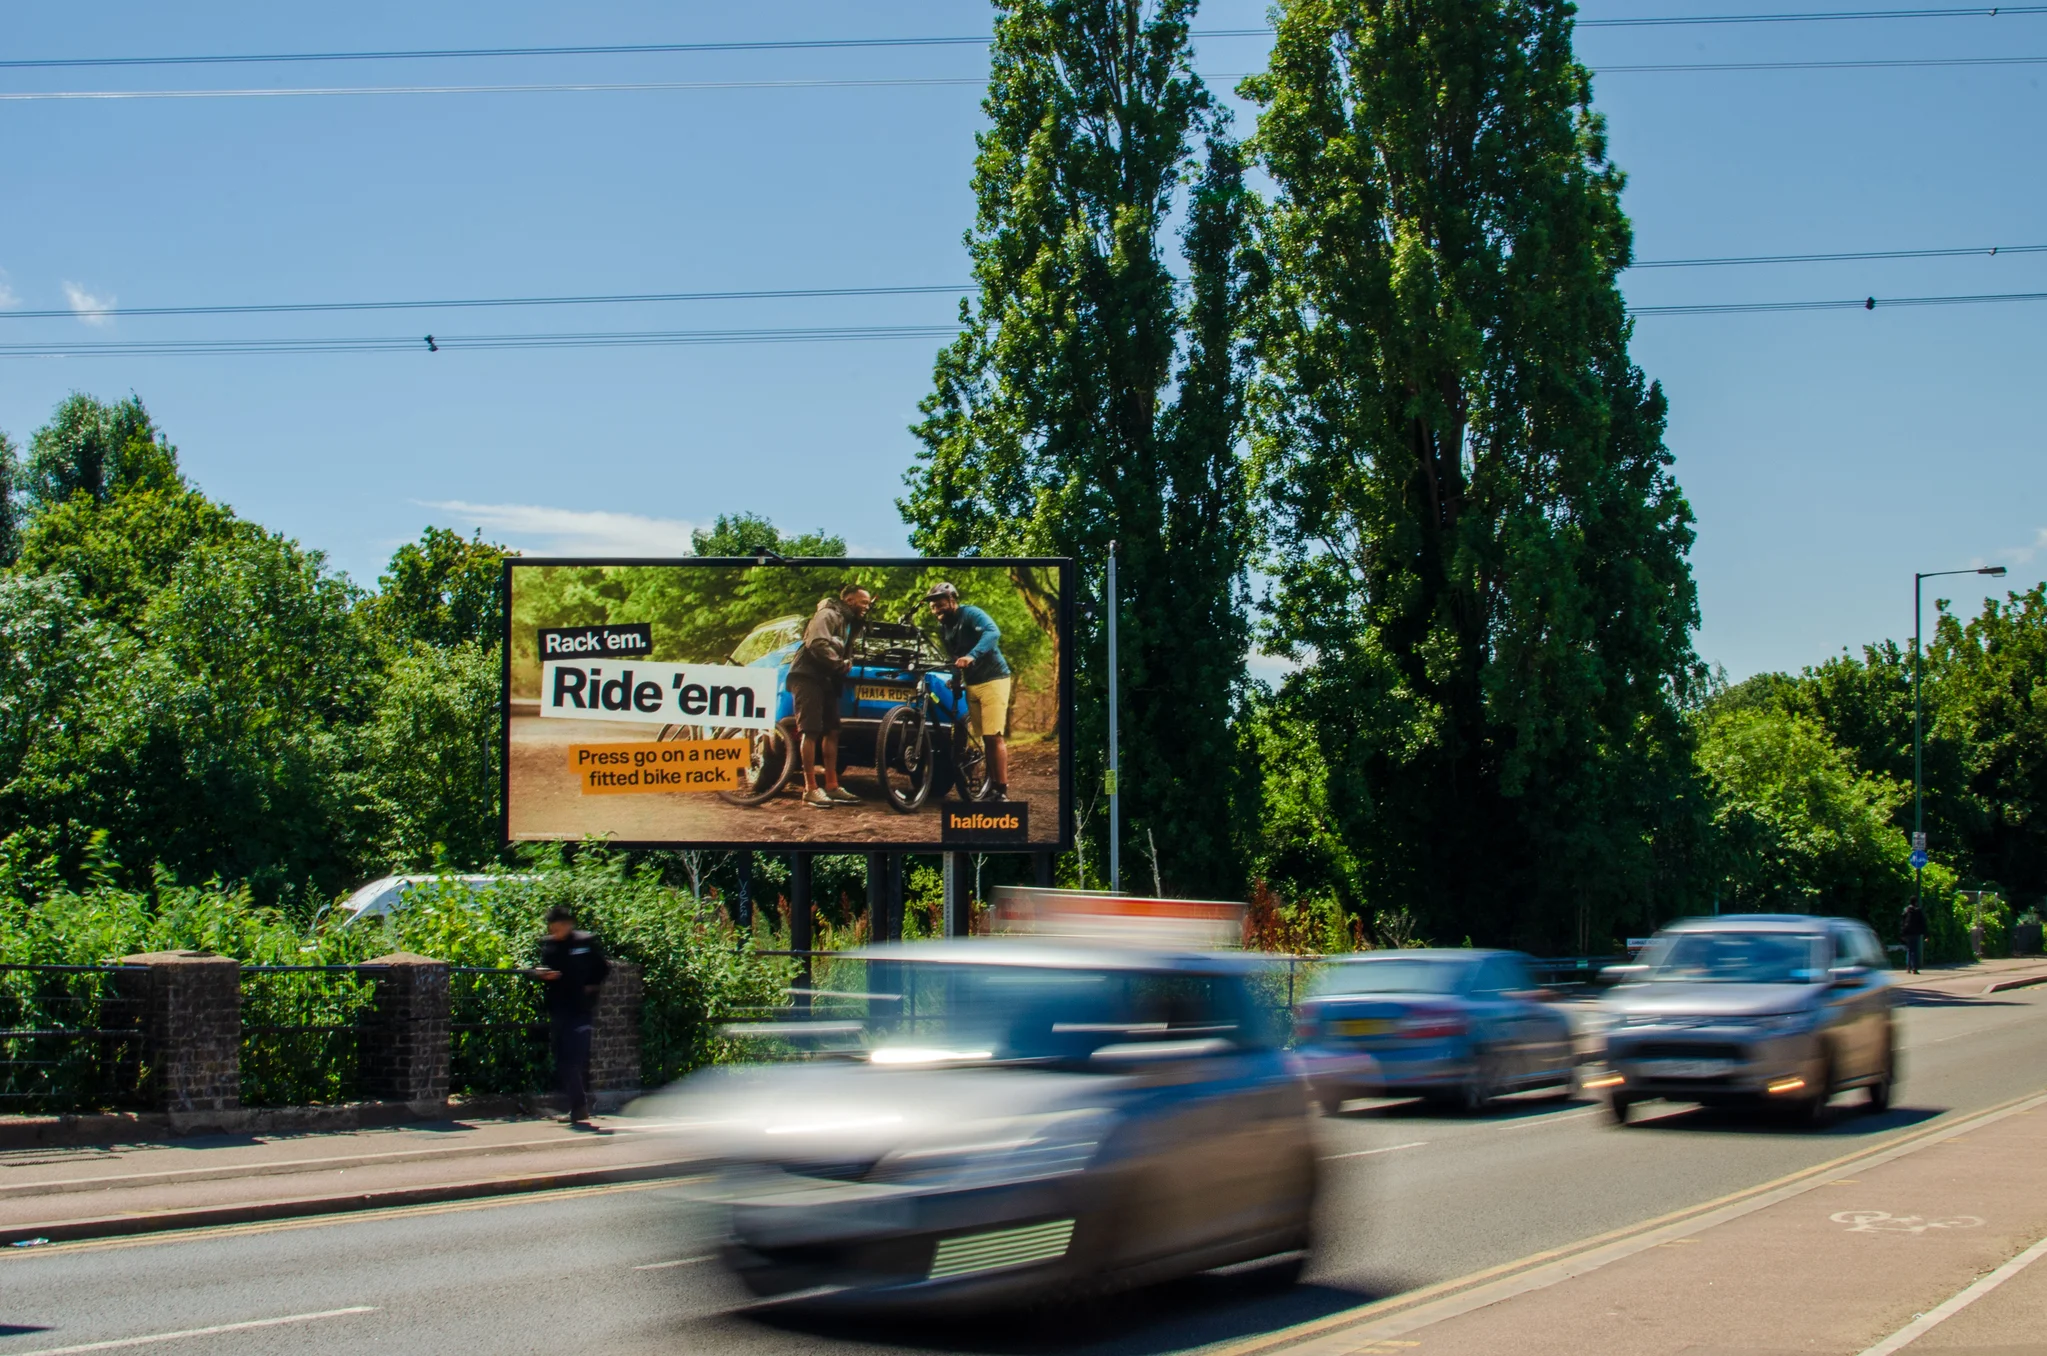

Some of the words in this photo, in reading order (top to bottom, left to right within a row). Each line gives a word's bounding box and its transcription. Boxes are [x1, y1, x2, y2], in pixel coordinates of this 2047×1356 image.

[545, 631, 601, 653] Rack
[553, 666, 663, 713] Ride
[672, 673, 766, 718] 'em.
[578, 749, 630, 765] Press
[634, 751, 657, 767] go
[661, 749, 684, 762] on
[688, 749, 699, 761] a
[703, 747, 741, 760] new
[589, 769, 639, 786] fitted
[643, 768, 682, 785] bike
[686, 766, 731, 783] rack.
[950, 813, 1019, 829] halfords
